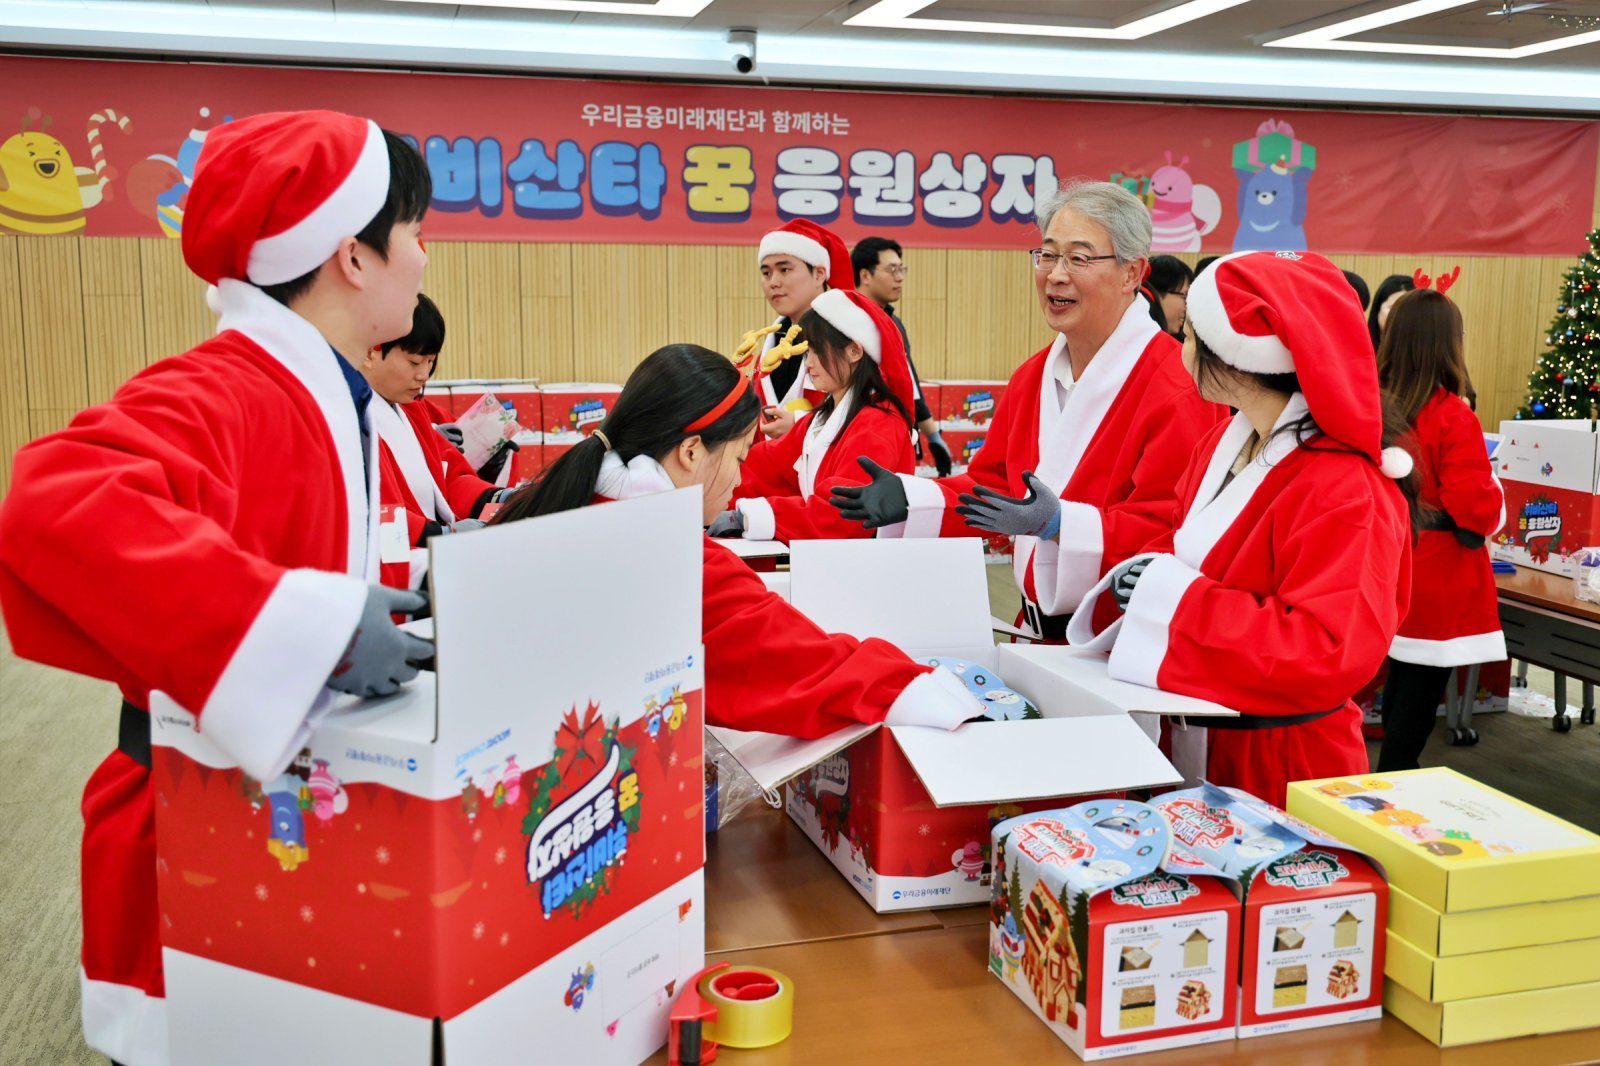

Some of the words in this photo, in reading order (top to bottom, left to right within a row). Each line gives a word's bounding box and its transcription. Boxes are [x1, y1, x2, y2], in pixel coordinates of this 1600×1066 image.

[581, 103, 766, 133] 우리금융미래재단과
[771, 110, 851, 136] 함께하는
[401, 135, 669, 220] 비산타
[682, 144, 757, 224] 꿈
[773, 146, 1058, 228] 응원상자
[526, 786, 615, 883] 응원상자
